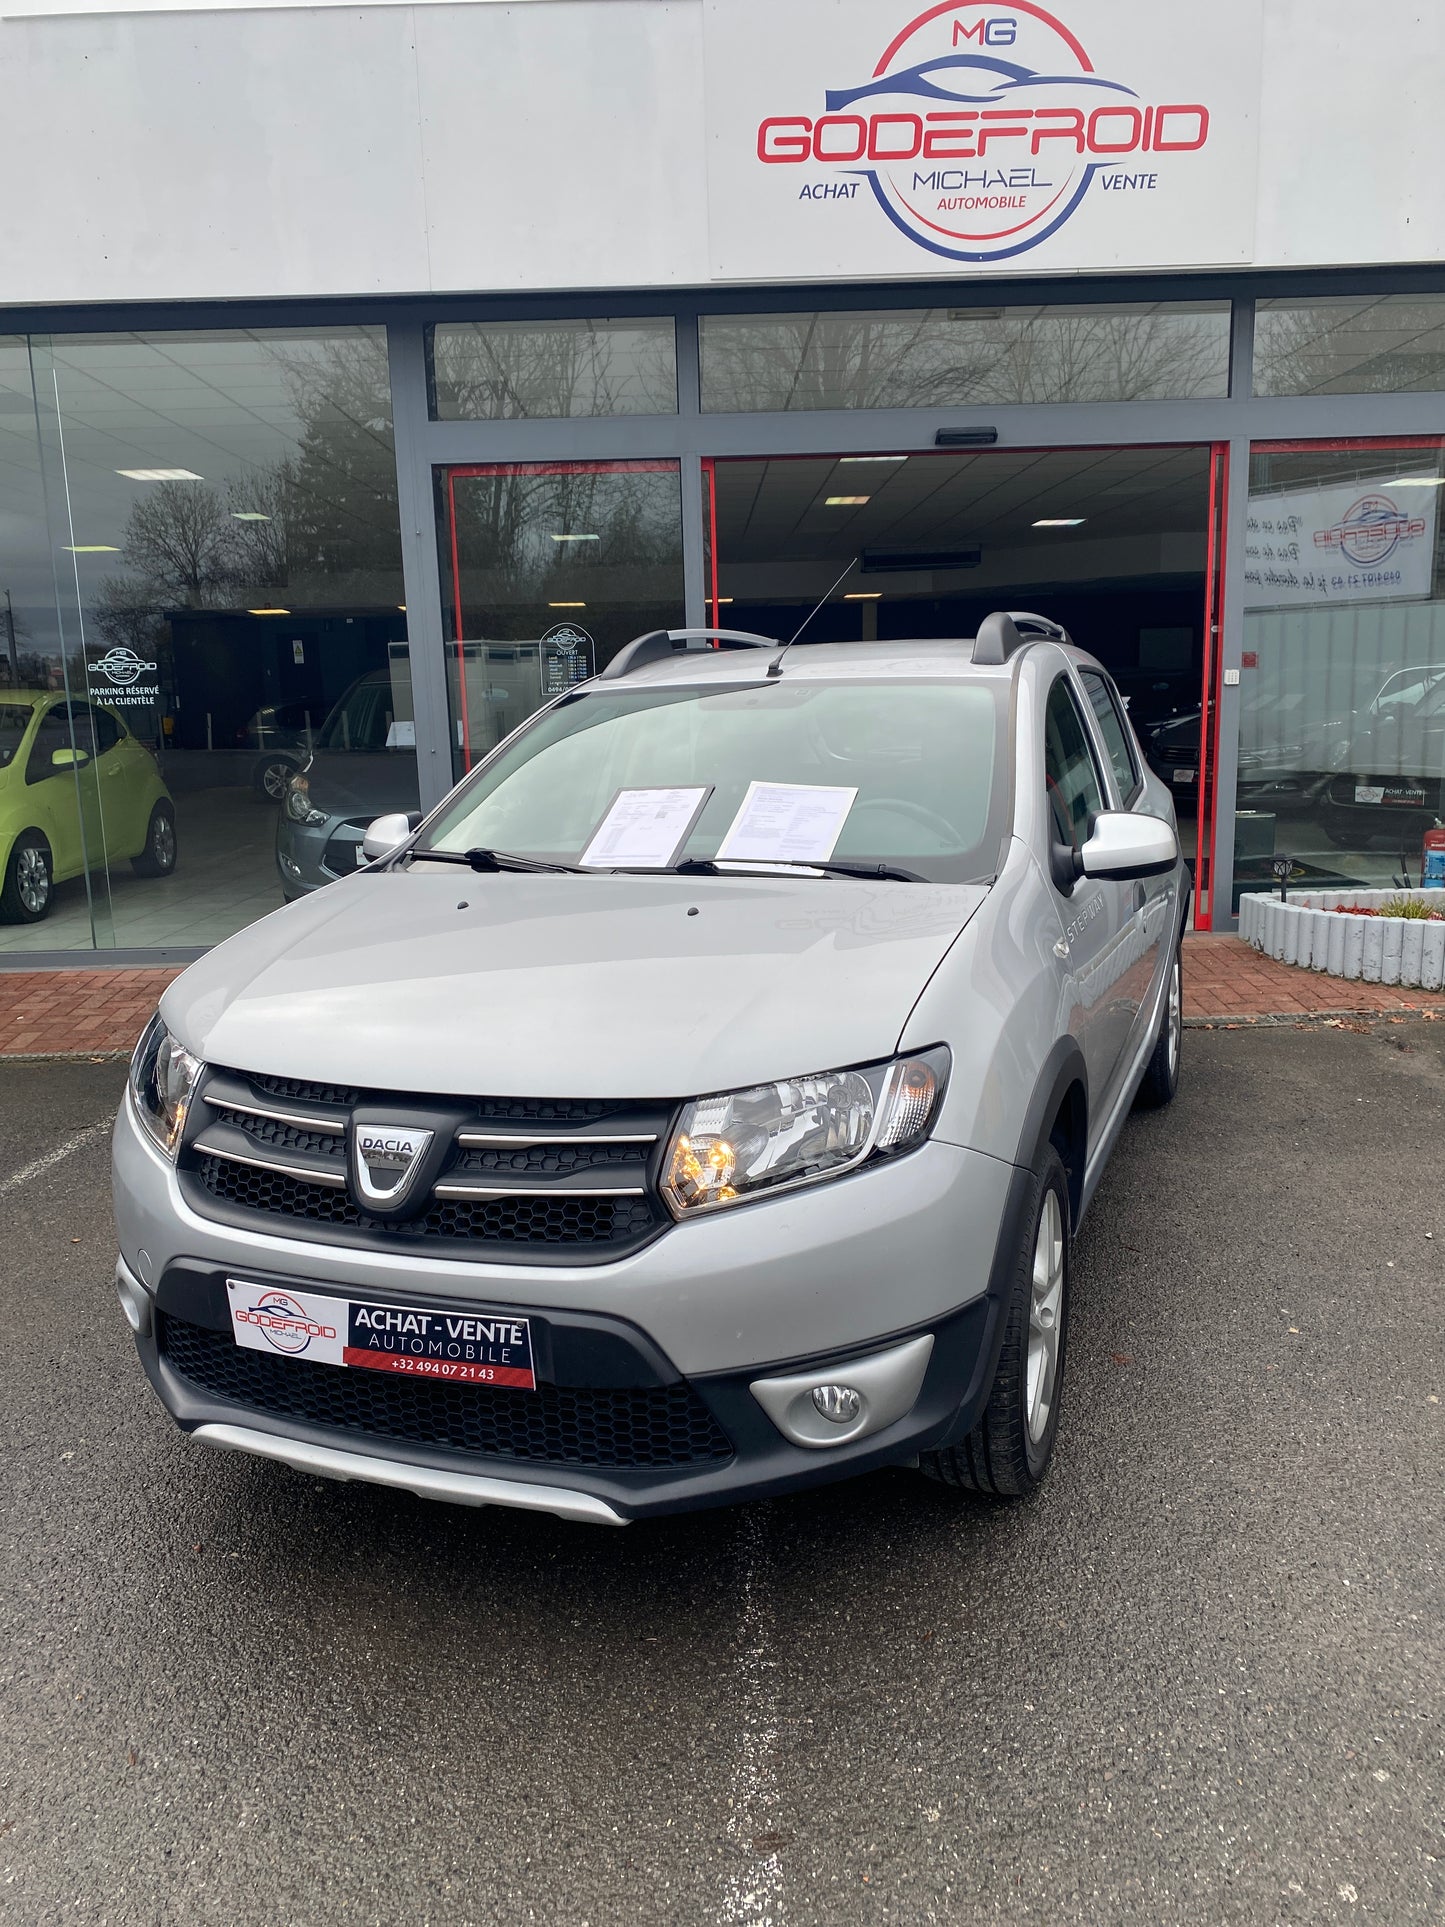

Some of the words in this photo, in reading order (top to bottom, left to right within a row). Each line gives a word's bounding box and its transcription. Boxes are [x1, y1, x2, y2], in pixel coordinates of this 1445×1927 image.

[952, 18, 1017, 47] MG
[756, 104, 1210, 164] GODEFROID
[913, 168, 1053, 191] MICHAEL
[1102, 173, 1158, 191] VENTE
[799, 182, 860, 201] ACHAT
[936, 195, 1027, 211] AUTOMOBILE
[90, 687, 124, 696] PARKING
[126, 685, 159, 695] RÉSERVÉ
[97, 696, 103, 705] À
[115, 695, 155, 705] CLIENTÈLE
[1067, 893, 1104, 943] STEPWAY
[363, 1138, 413, 1152] DACIA
[273, 1297, 288, 1306] MG
[235, 1310, 336, 1339] GODEFROID
[270, 1329, 302, 1339] MICHAEL
[355, 1308, 431, 1335] ACHAT
[446, 1318, 523, 1345] VENTE
[369, 1333, 511, 1364] AUTOMOBILE
[391, 1358, 413, 1370] +32
[416, 1361, 440, 1374] 494
[441, 1364, 458, 1376] 07
[460, 1366, 475, 1378] 21
[478, 1368, 495, 1380] 43
